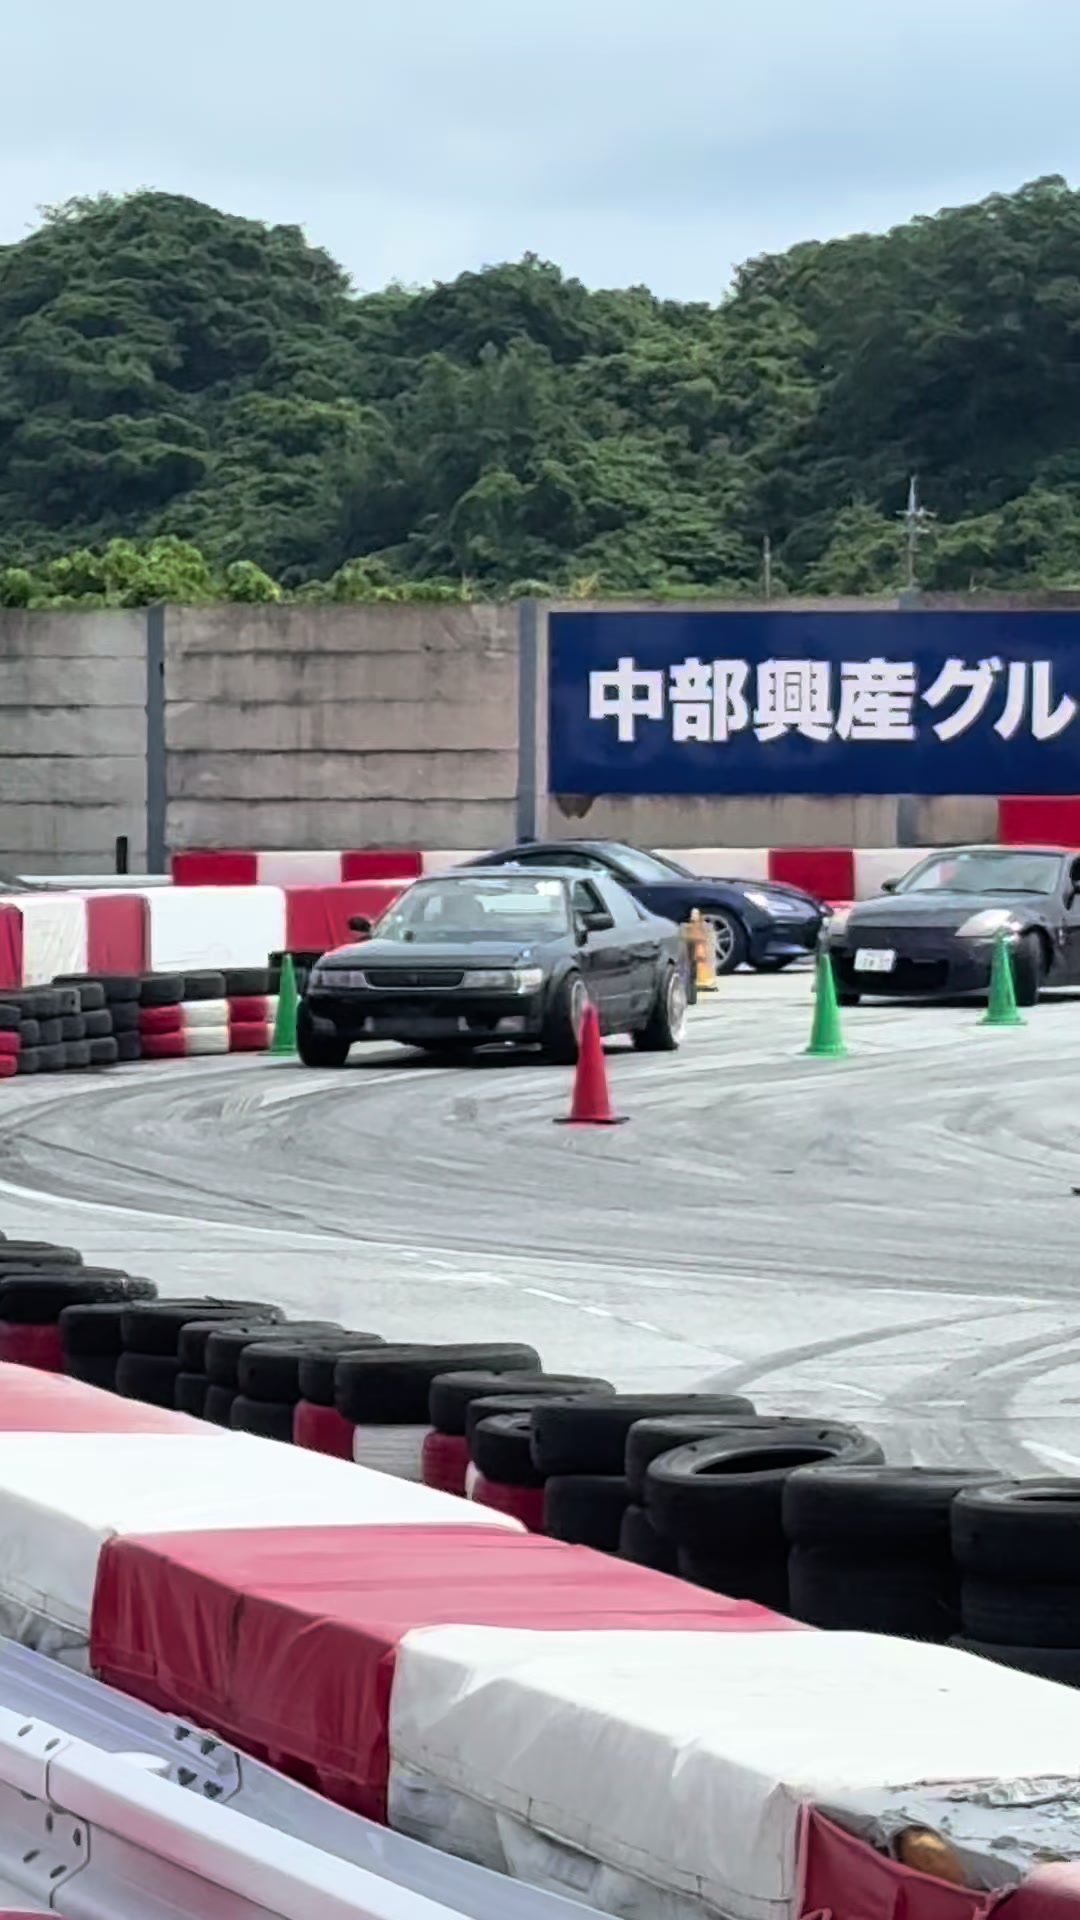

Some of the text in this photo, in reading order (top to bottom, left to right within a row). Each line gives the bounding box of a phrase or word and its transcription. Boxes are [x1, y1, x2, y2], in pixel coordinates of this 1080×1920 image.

[589, 656, 1077, 742] 中部興産グル
